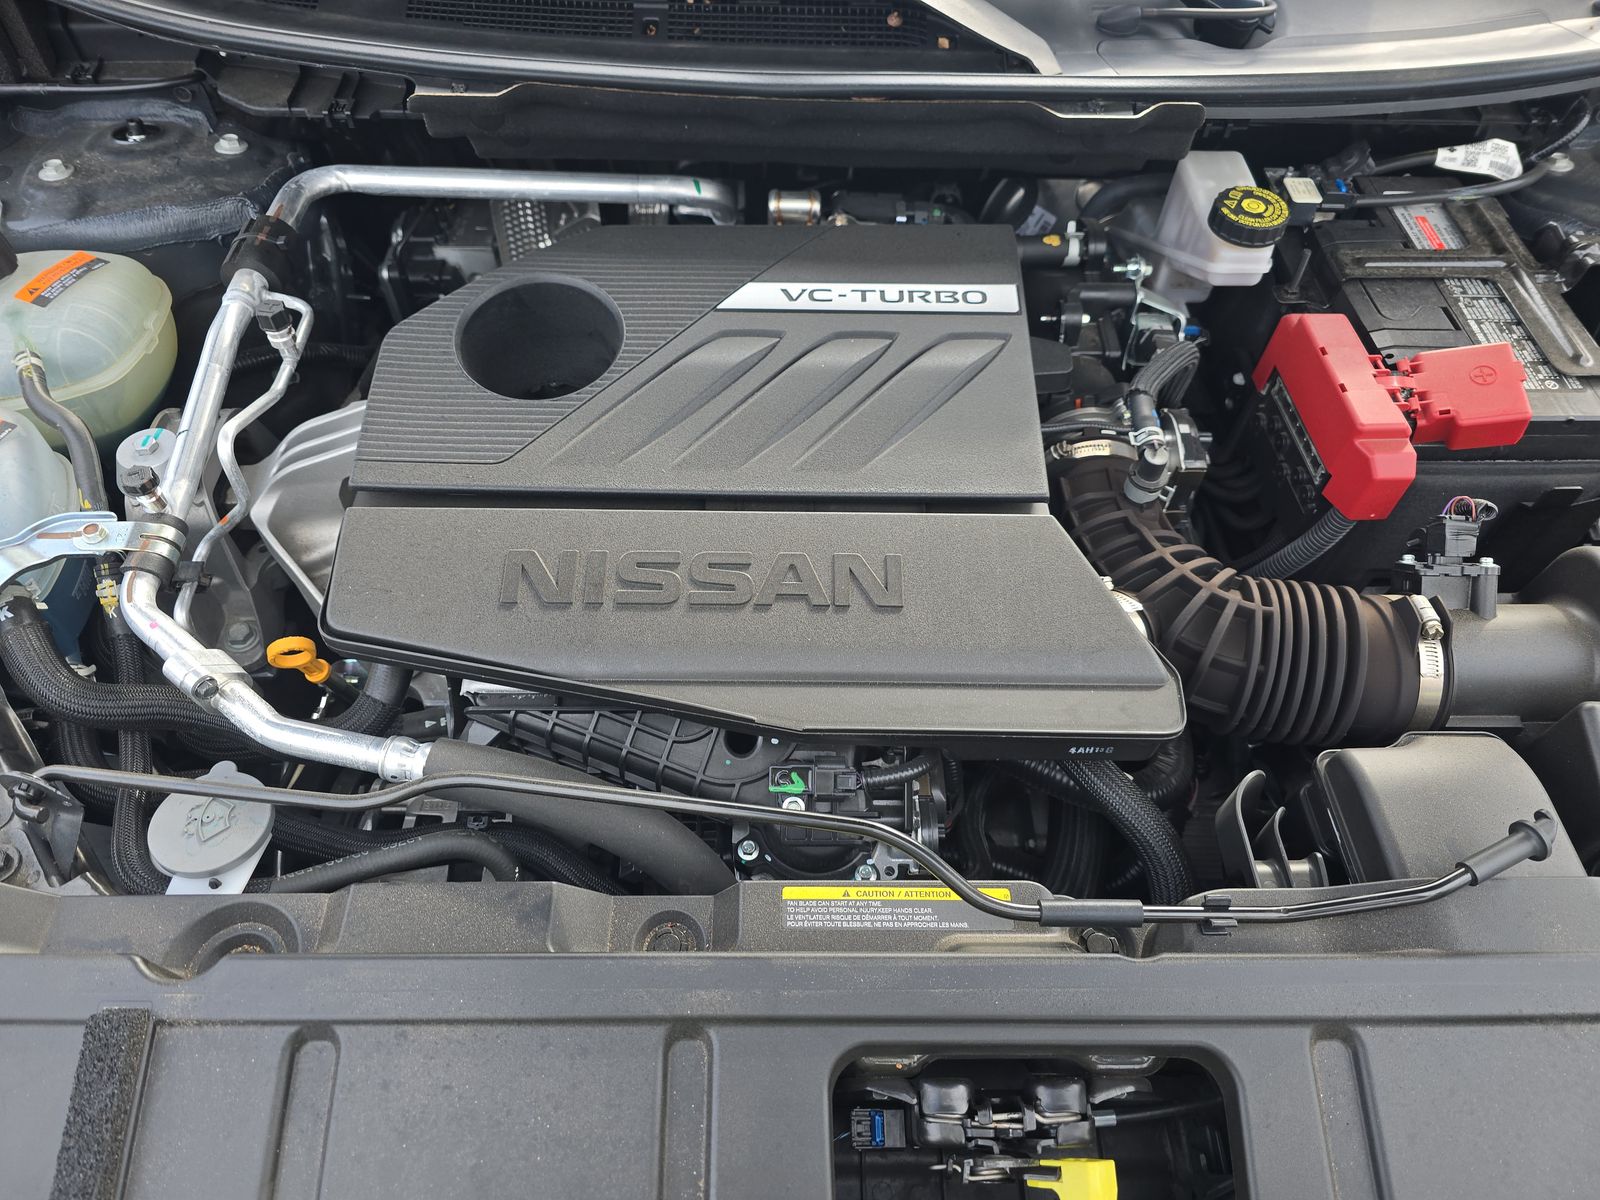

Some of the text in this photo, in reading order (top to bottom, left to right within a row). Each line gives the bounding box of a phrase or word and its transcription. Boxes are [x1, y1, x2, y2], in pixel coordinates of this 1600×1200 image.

[780, 288, 988, 305] VC-TURBO
[499, 549, 904, 608] NISSAN
[855, 890, 895, 898] CAUTION
[904, 890, 952, 898] ATTENTION
[861, 913, 892, 921] DÉMARRER
[892, 913, 898, 921] À
